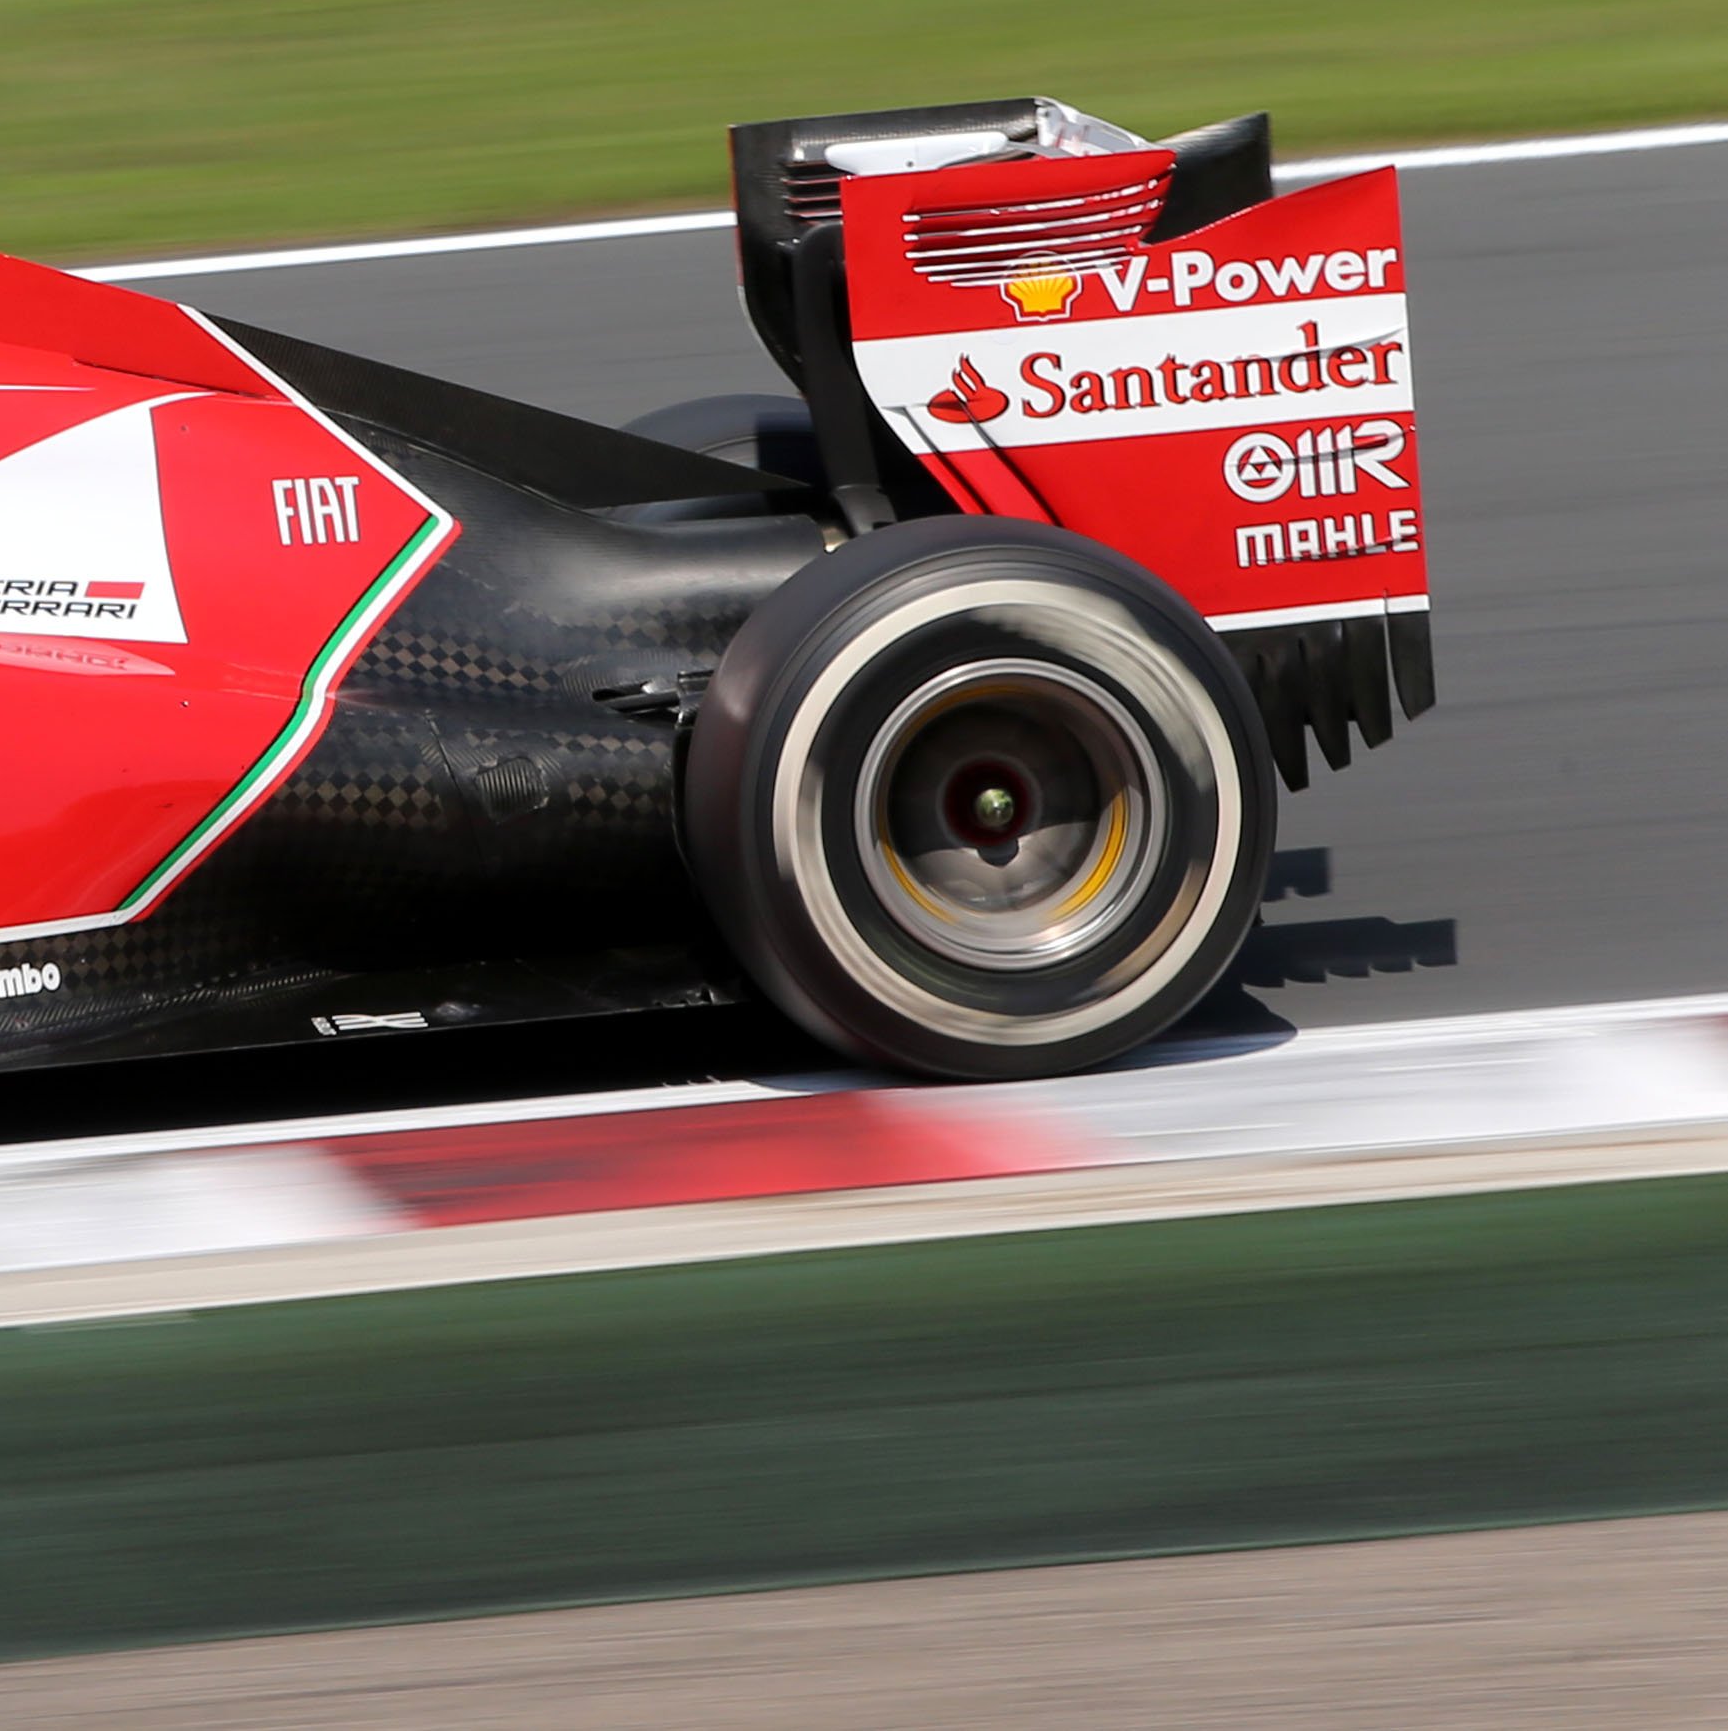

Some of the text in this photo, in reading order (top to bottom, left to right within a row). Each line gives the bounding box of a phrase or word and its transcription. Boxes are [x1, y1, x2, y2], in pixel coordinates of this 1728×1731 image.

[1095, 248, 1397, 312] V-Power
[1020, 320, 1404, 418] Santander
[271, 477, 361, 545] FIAT
[1236, 509, 1420, 568] MAHLE
